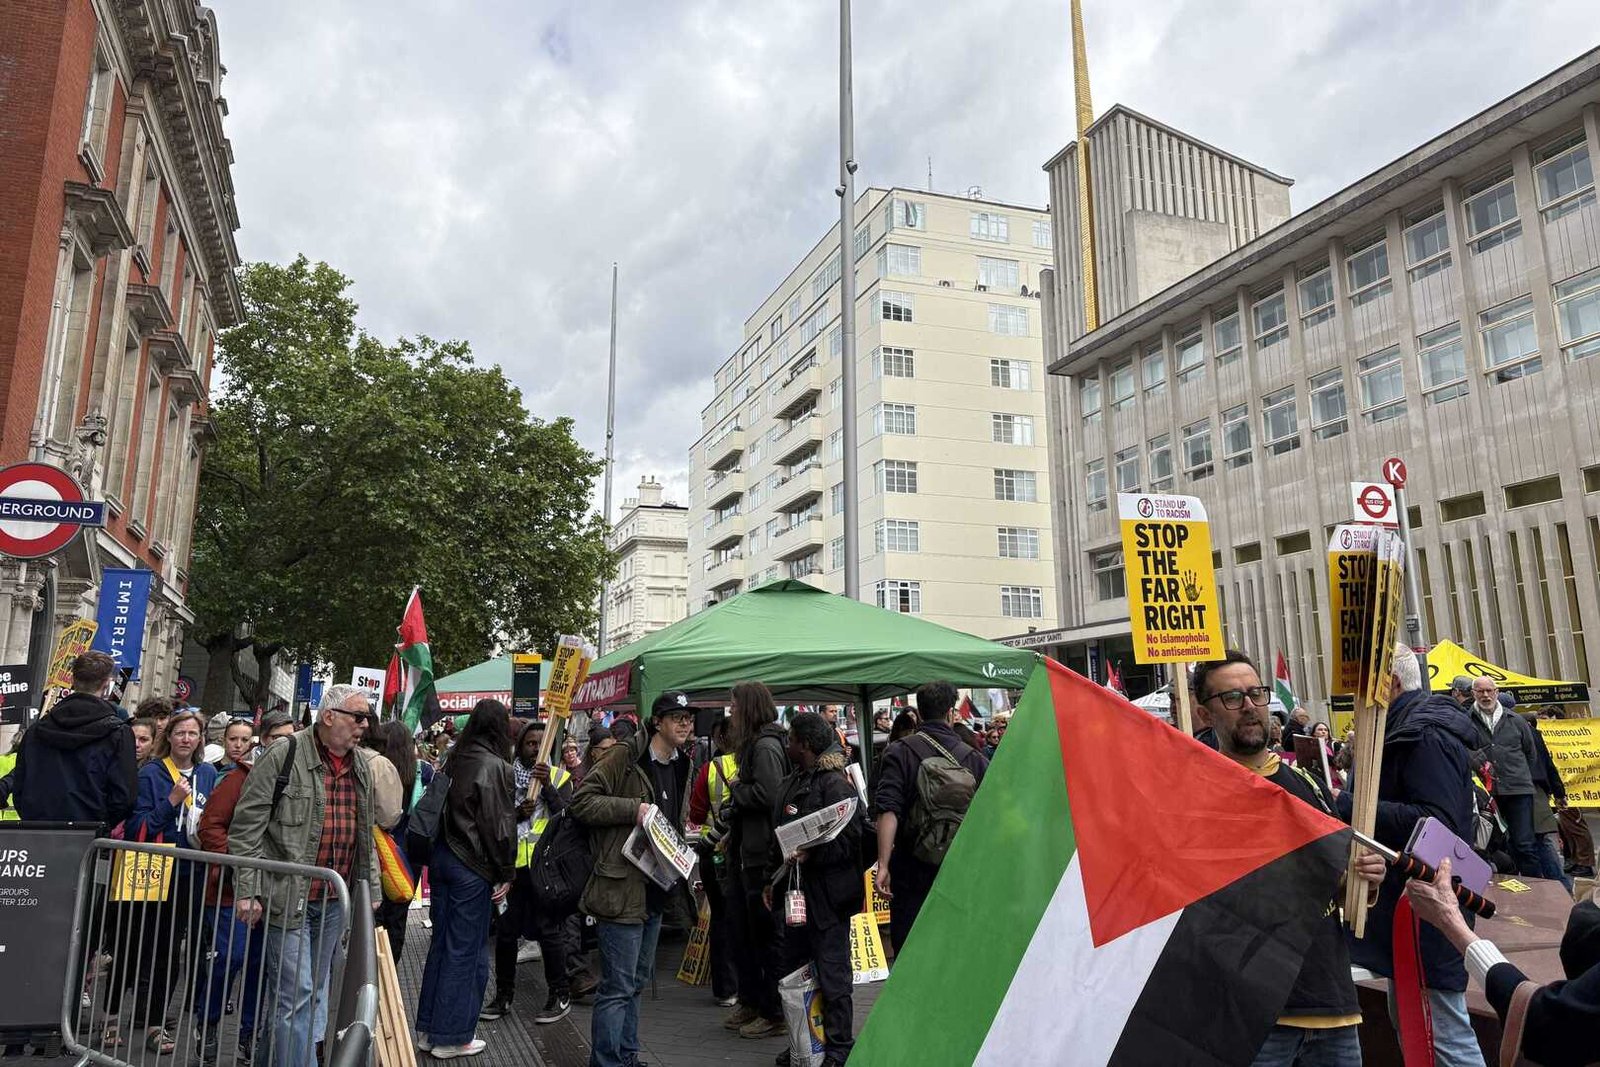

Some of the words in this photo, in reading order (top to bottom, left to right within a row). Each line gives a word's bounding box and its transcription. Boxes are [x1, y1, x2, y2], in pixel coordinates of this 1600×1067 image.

[1388, 462, 1403, 481] K
[0, 503, 94, 519] ERGROUND
[1155, 500, 1176, 509] STAND
[1177, 501, 1187, 509] UP
[1156, 509, 1165, 518] TO
[1166, 510, 1191, 519] RACISM
[1135, 523, 1189, 548] STOP
[1137, 550, 1179, 574] THE
[1141, 577, 1181, 603] FAR
[1144, 605, 1206, 631] RIGHT
[1146, 634, 1158, 644] No
[1160, 632, 1210, 645] Islamophobia
[559, 647, 575, 659] STOP
[1148, 647, 1160, 657] No
[1161, 646, 1211, 657] antisemitism
[0, 864, 46, 877] ANCE
